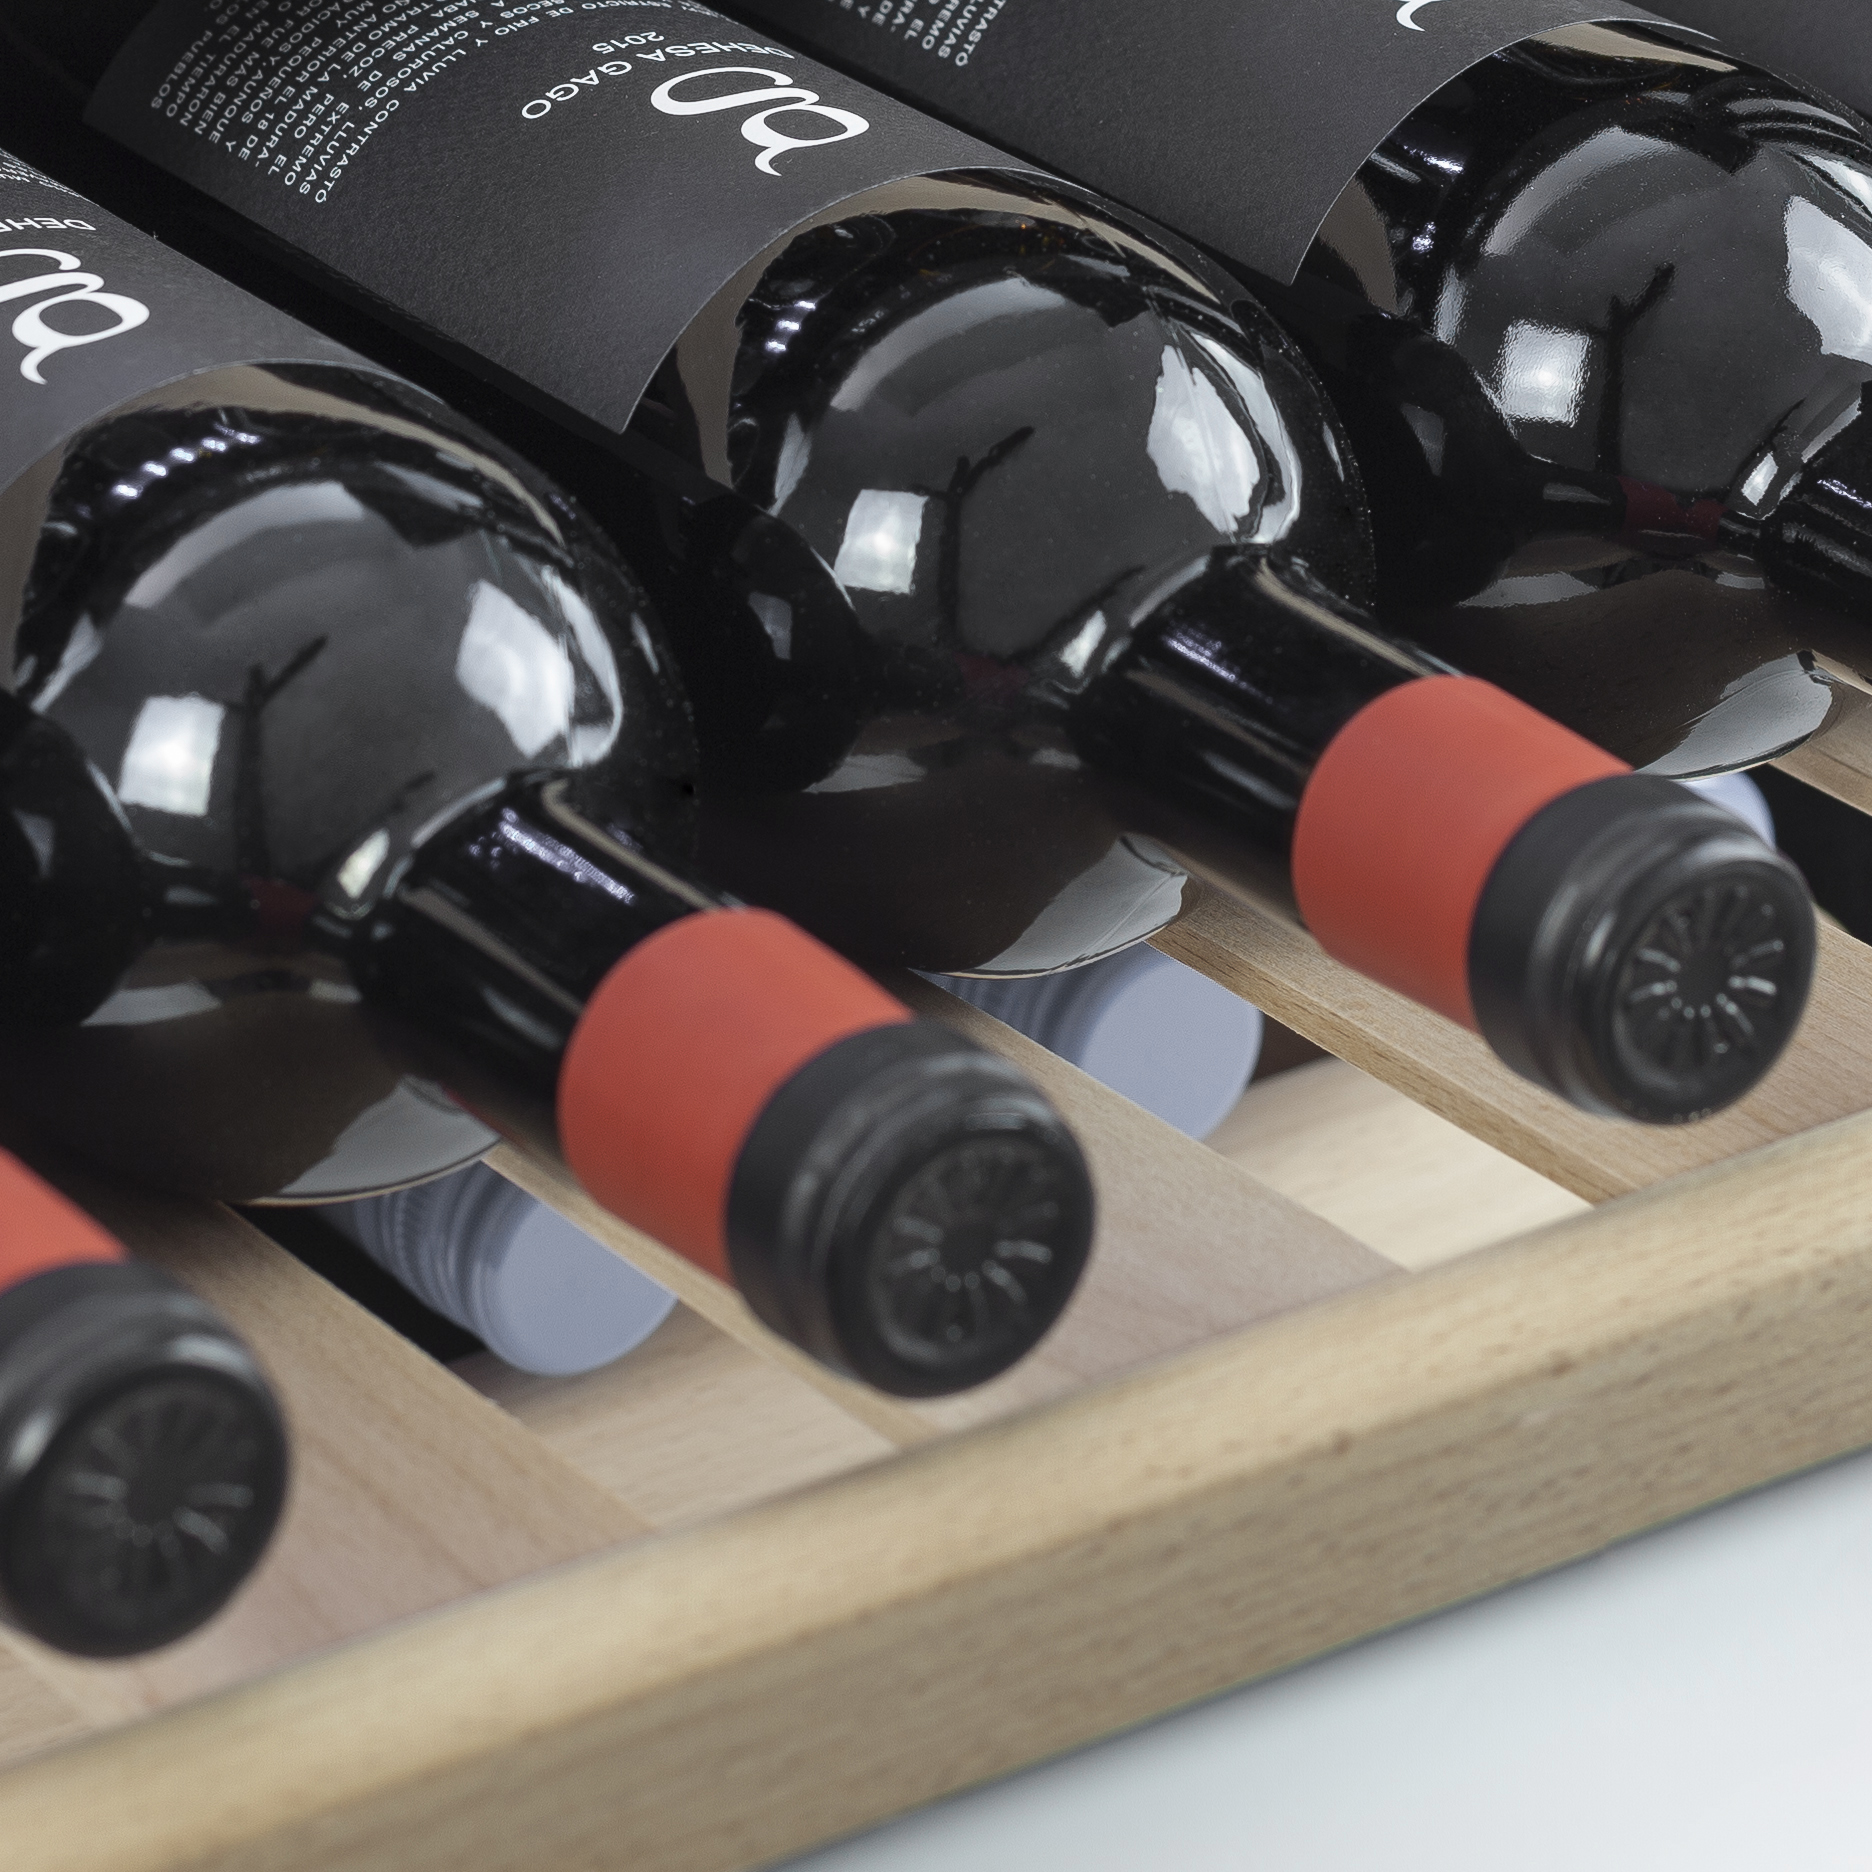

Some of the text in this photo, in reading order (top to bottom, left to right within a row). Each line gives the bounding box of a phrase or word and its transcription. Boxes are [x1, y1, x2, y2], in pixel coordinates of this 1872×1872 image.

[369, 3, 433, 40] TRAMO
[592, 30, 666, 54] 2015
[318, 64, 341, 81] LA
[341, 42, 366, 62] DE
[404, 49, 466, 91] LLUVIA
[209, 70, 262, 143] AUNQUE
[239, 14, 376, 160] ANTERIOR EL 18 DE
[285, 10, 479, 185] SEMANAS DE EXTREMO
[521, 60, 633, 119] GAGO
[195, 92, 226, 134] BIEN
[294, 94, 334, 138] PERO
[268, 154, 286, 174] EL
[300, 122, 354, 194] LLUVIAS
